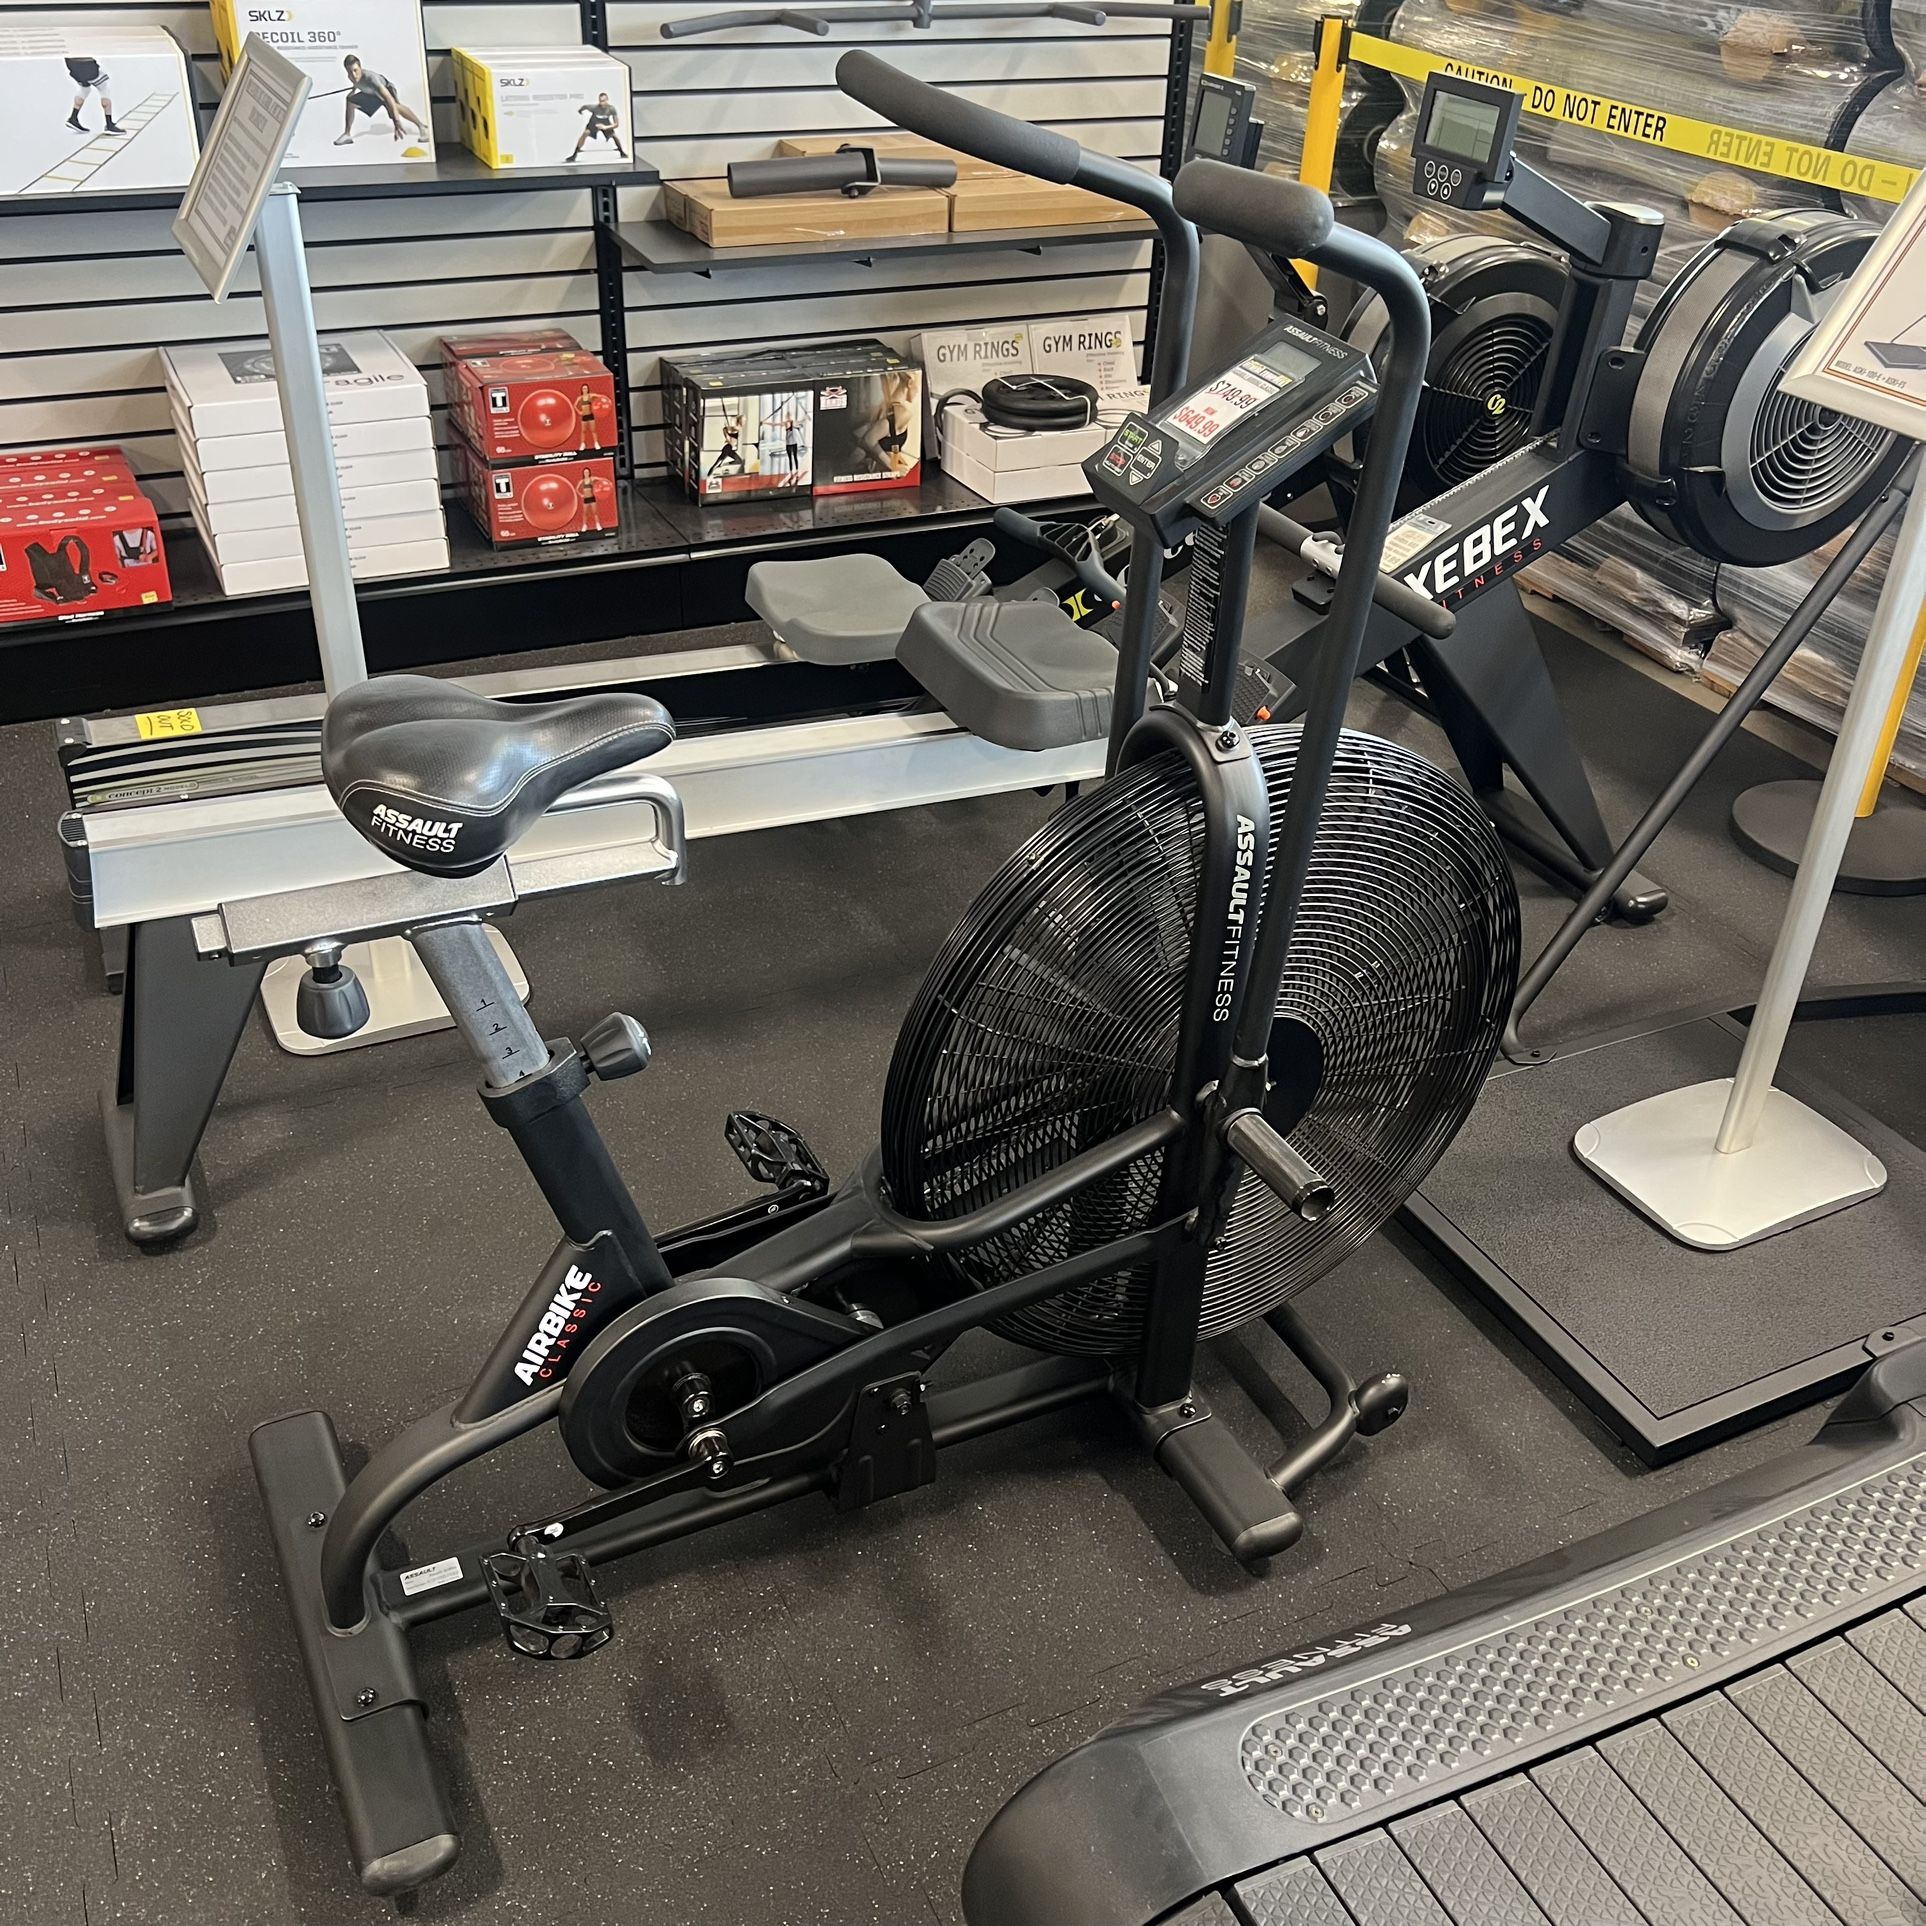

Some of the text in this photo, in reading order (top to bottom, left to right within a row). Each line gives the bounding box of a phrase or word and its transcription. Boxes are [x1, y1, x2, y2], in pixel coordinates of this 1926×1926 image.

[248, 10, 286, 22] SKLZ
[500, 78, 525, 87] SKLZ
[1531, 85, 1667, 142] DO NOT ENTER
[937, 339, 1019, 363] GYM RINGS
[1043, 334, 1073, 354] GYM
[326, 374, 404, 386] agile
[1209, 379, 1257, 410] $749.99
[1173, 405, 1220, 438] $649.99
[1136, 454, 1156, 470] ENTER
[1403, 484, 1550, 600] XEBEX
[1441, 538, 1542, 610] ITNESS
[371, 815, 456, 853] FITNESS
[373, 804, 464, 838] ASSAULT
[514, 1264, 593, 1386] AIRBIKE
[539, 1281, 602, 1378] CLASSIC
[404, 1566, 436, 1580] ASSAULT
[1200, 1623, 1398, 1691] FITNESS
[1219, 1624, 1412, 1697] ASSAULT
